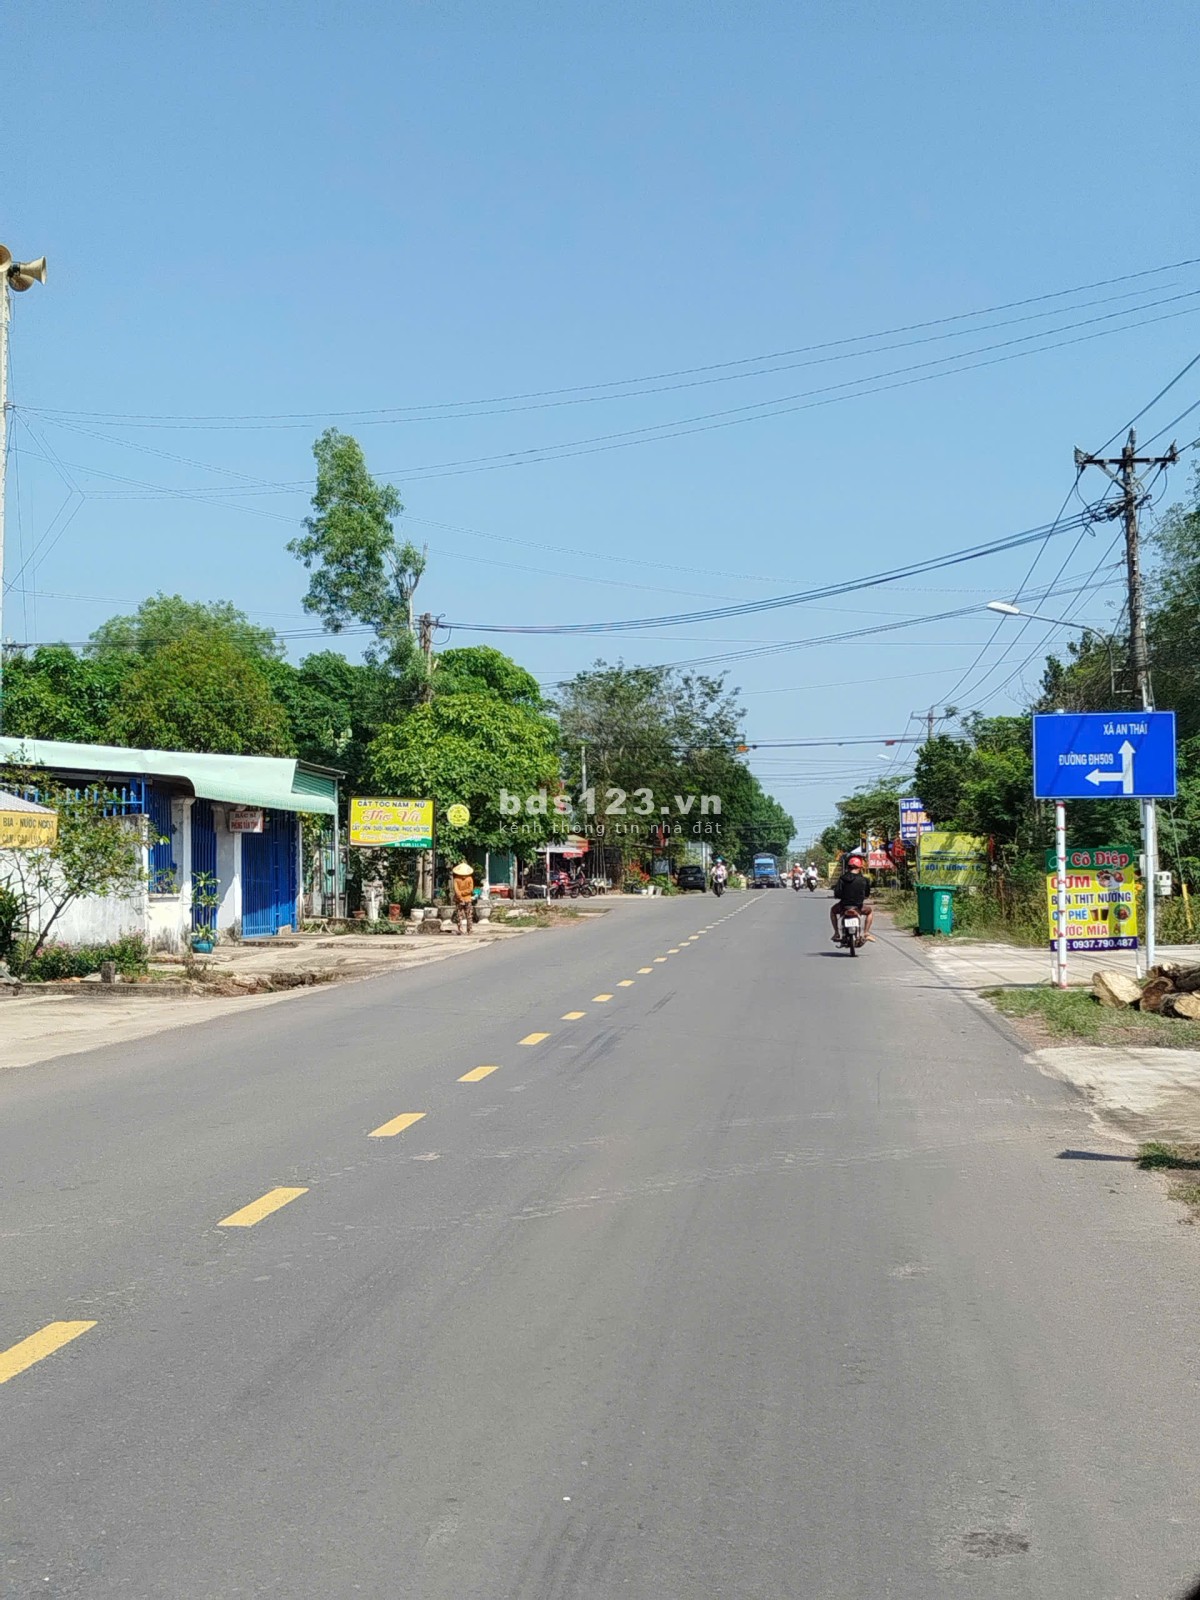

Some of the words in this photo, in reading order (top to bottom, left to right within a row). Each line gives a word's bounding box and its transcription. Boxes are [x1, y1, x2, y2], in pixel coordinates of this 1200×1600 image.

[1103, 722, 1114, 735] XÃ
[1116, 724, 1127, 735] AN
[1129, 721, 1147, 735] THÁI
[1059, 752, 1087, 765] ĐƯỜNG
[1088, 753, 1114, 765] ĐH509
[374, 800, 390, 808] TÓC
[3, 817, 14, 827] BIA
[1071, 852, 1090, 866] Cô
[1095, 851, 1129, 868] Điệp
[1051, 875, 1090, 889] CƠM
[1051, 894, 1071, 905] BN
[1075, 894, 1094, 906] THỊT
[1098, 891, 1131, 903] NƯỚNG
[1069, 908, 1087, 920] PHÊ
[1087, 925, 1108, 935] MÍA
[1072, 939, 1133, 949] 0937.790.487
